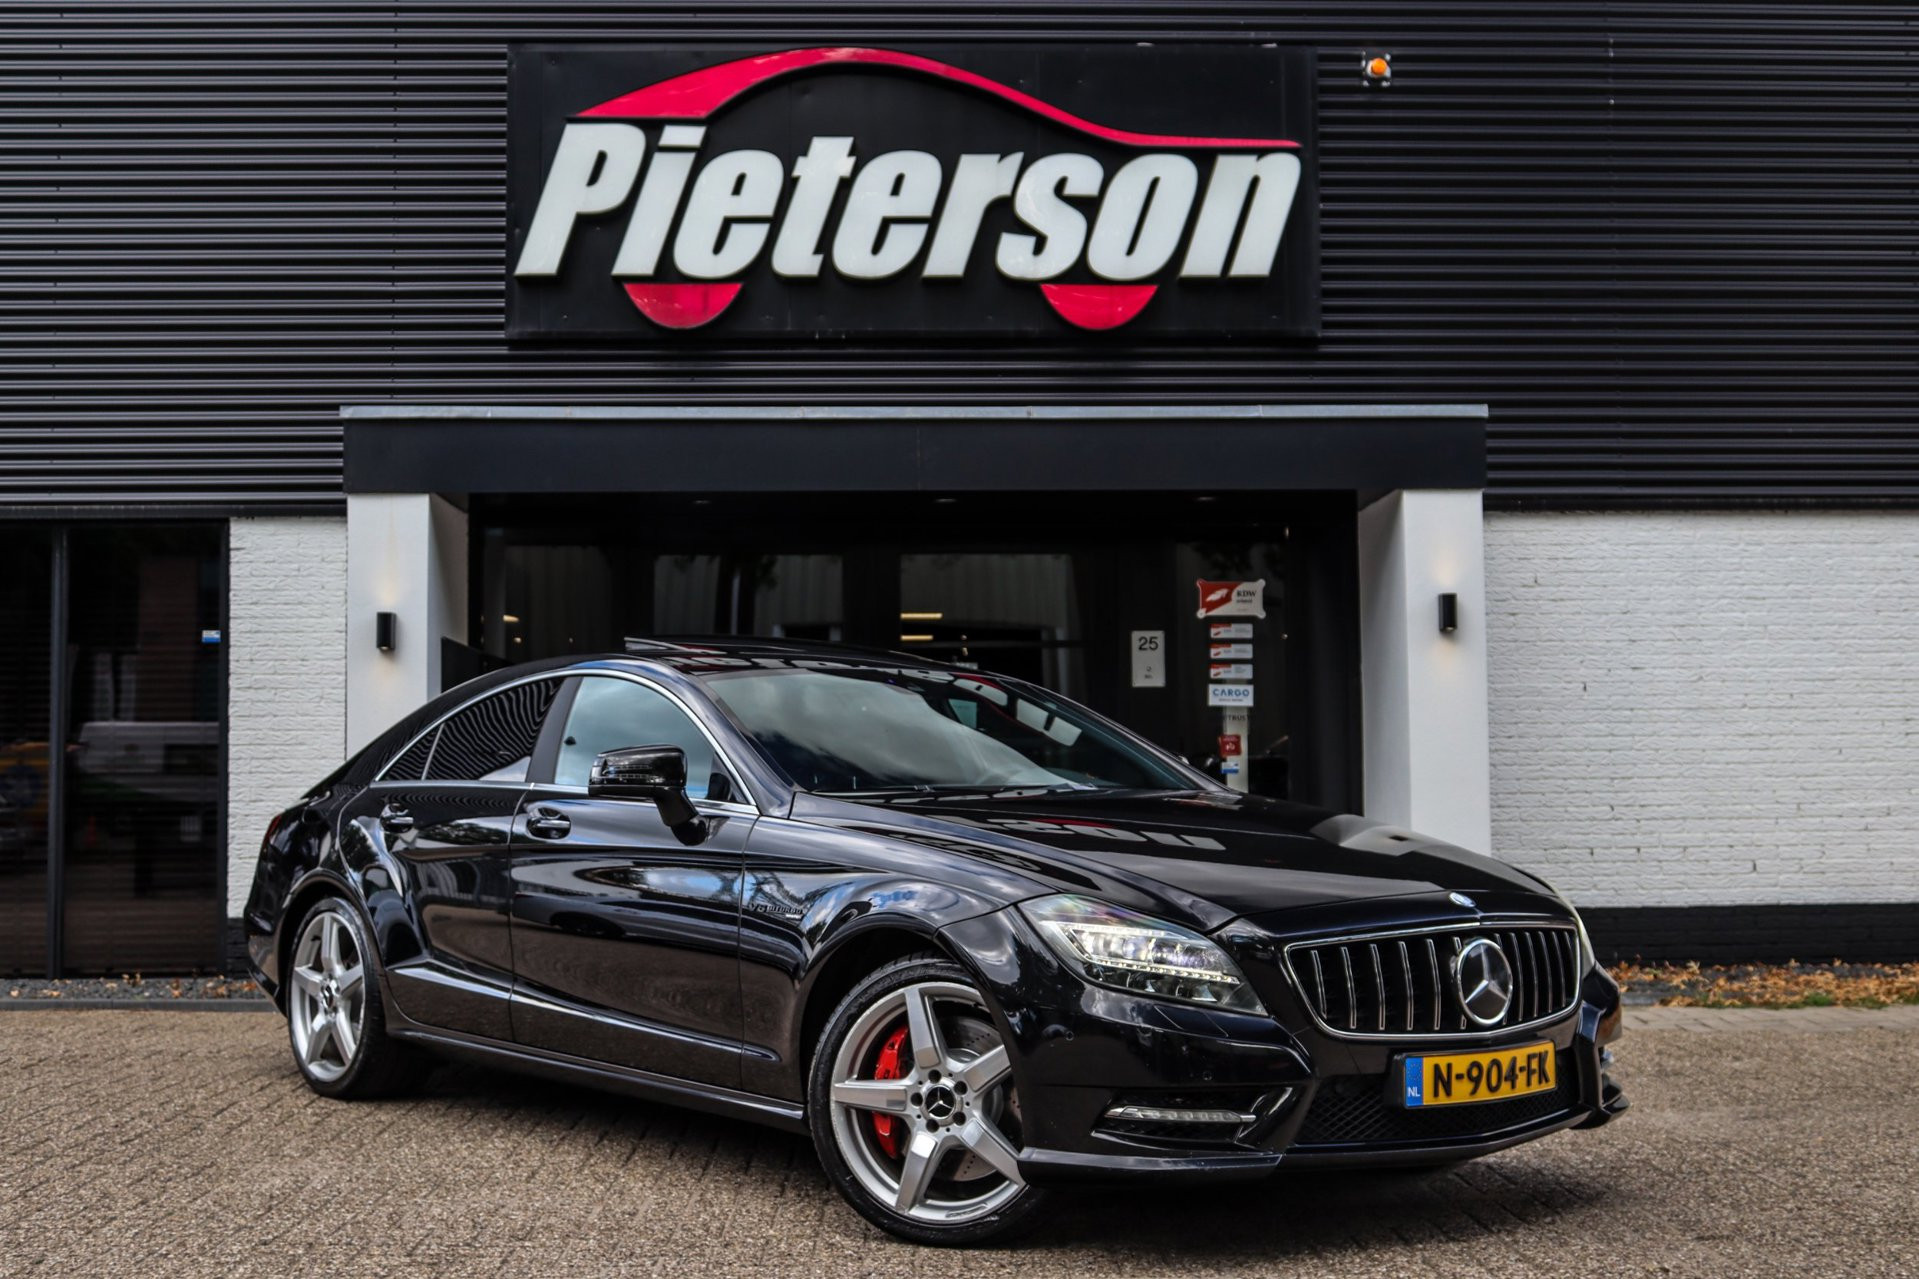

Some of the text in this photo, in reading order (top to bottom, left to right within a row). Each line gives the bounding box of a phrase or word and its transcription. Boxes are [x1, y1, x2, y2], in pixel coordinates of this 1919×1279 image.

[514, 122, 1301, 282] Pieterson
[1139, 635, 1158, 651] 25
[1212, 688, 1250, 697] CARGO
[1433, 1051, 1550, 1098] N-904-FK
[1407, 1088, 1421, 1098] NL
